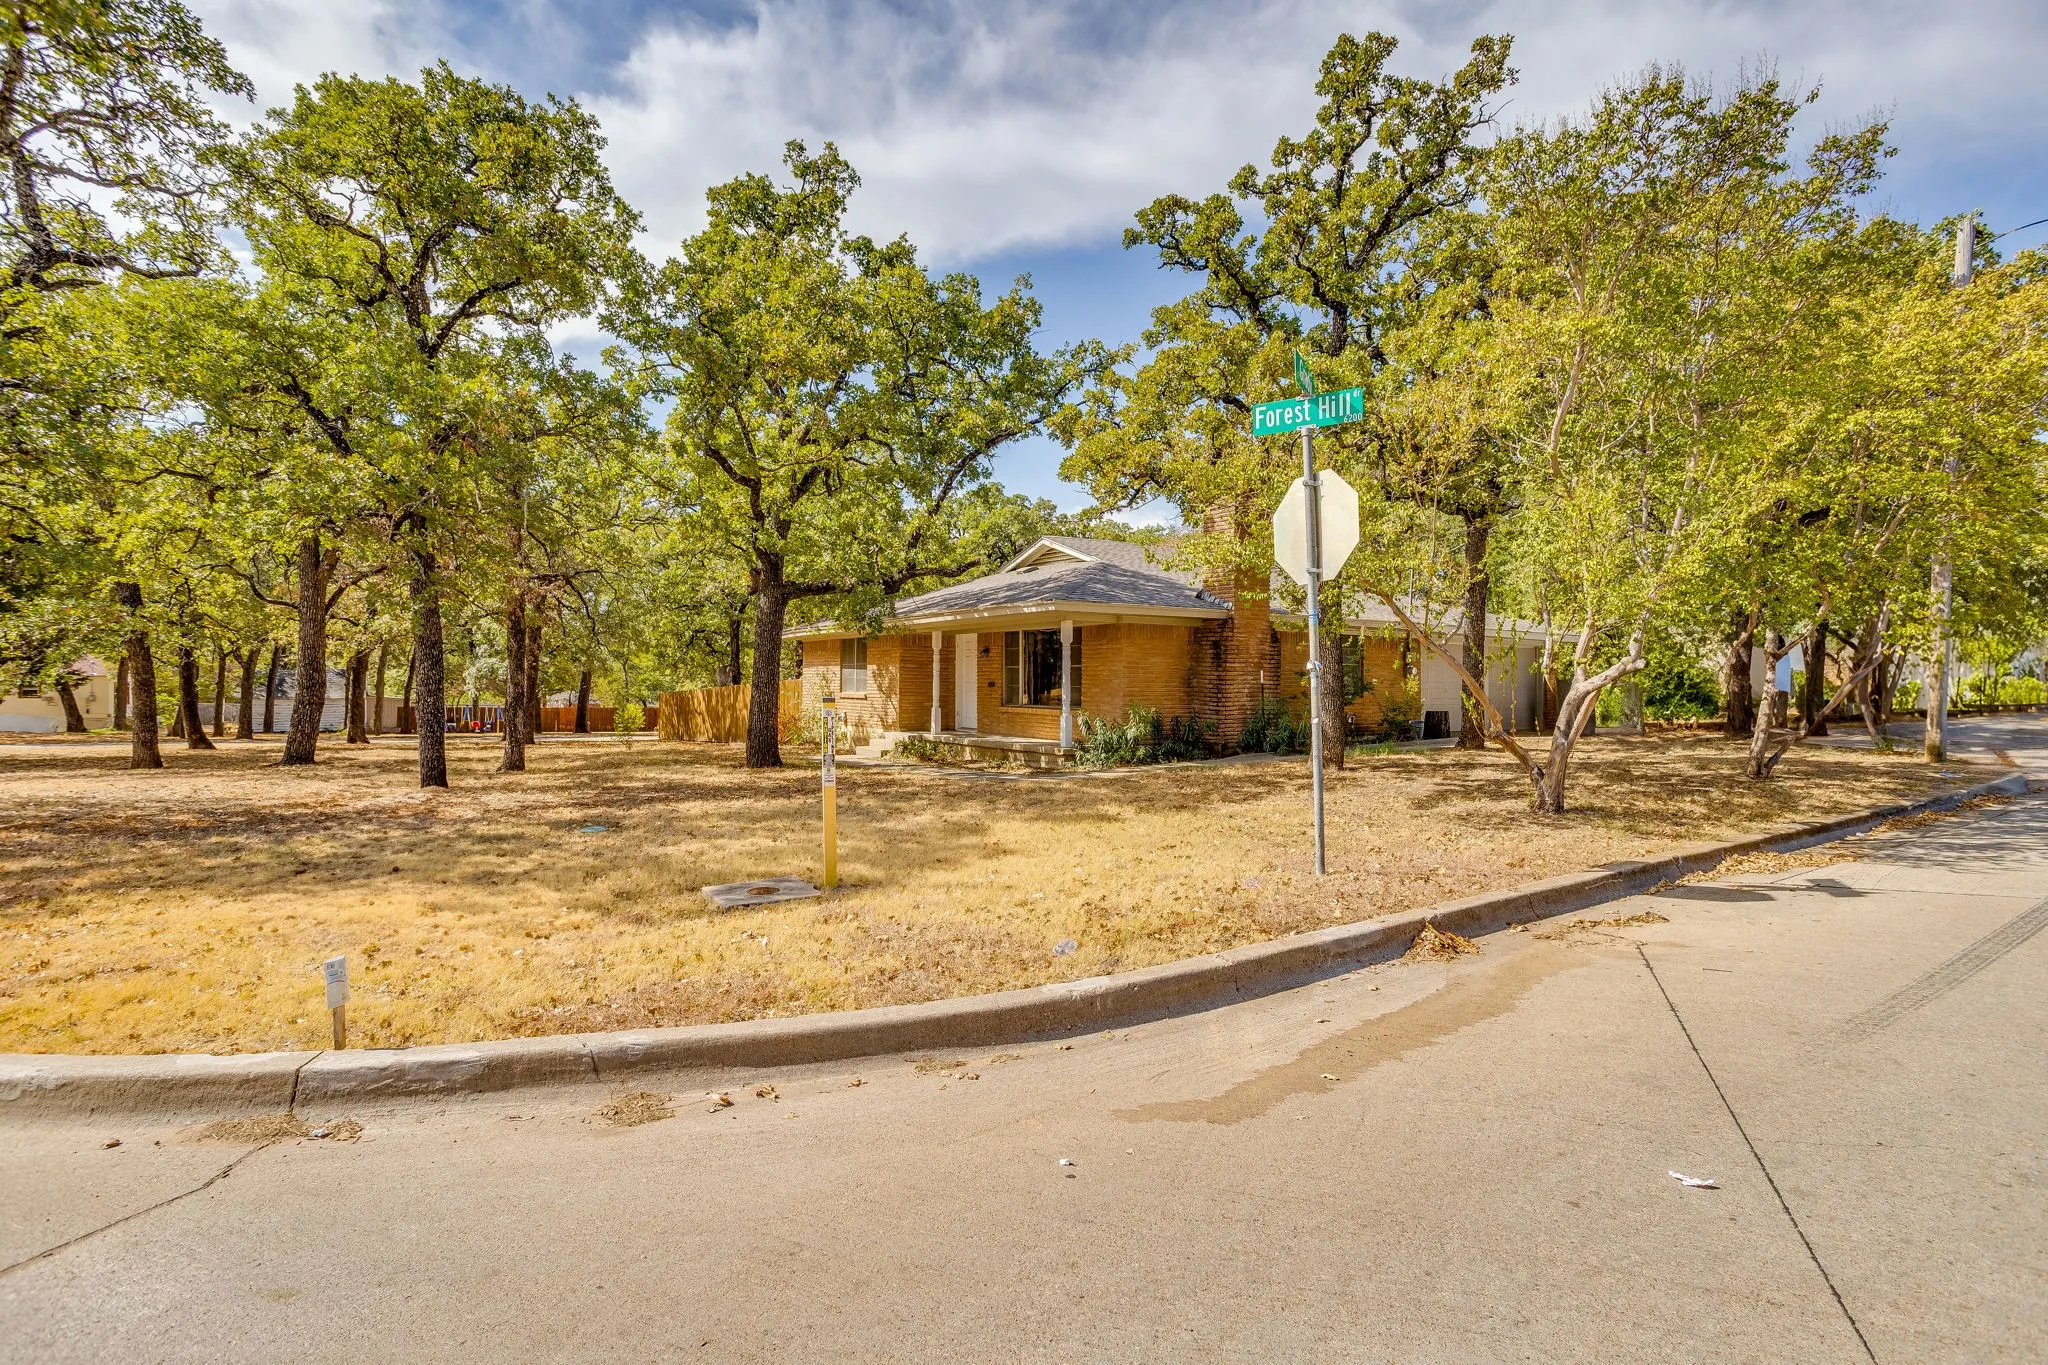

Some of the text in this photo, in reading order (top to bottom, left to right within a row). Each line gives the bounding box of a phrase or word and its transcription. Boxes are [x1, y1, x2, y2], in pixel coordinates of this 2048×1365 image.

[1255, 399, 1311, 430] Forest
[1318, 393, 1351, 420] Hill
[1343, 412, 1363, 424] 6200
